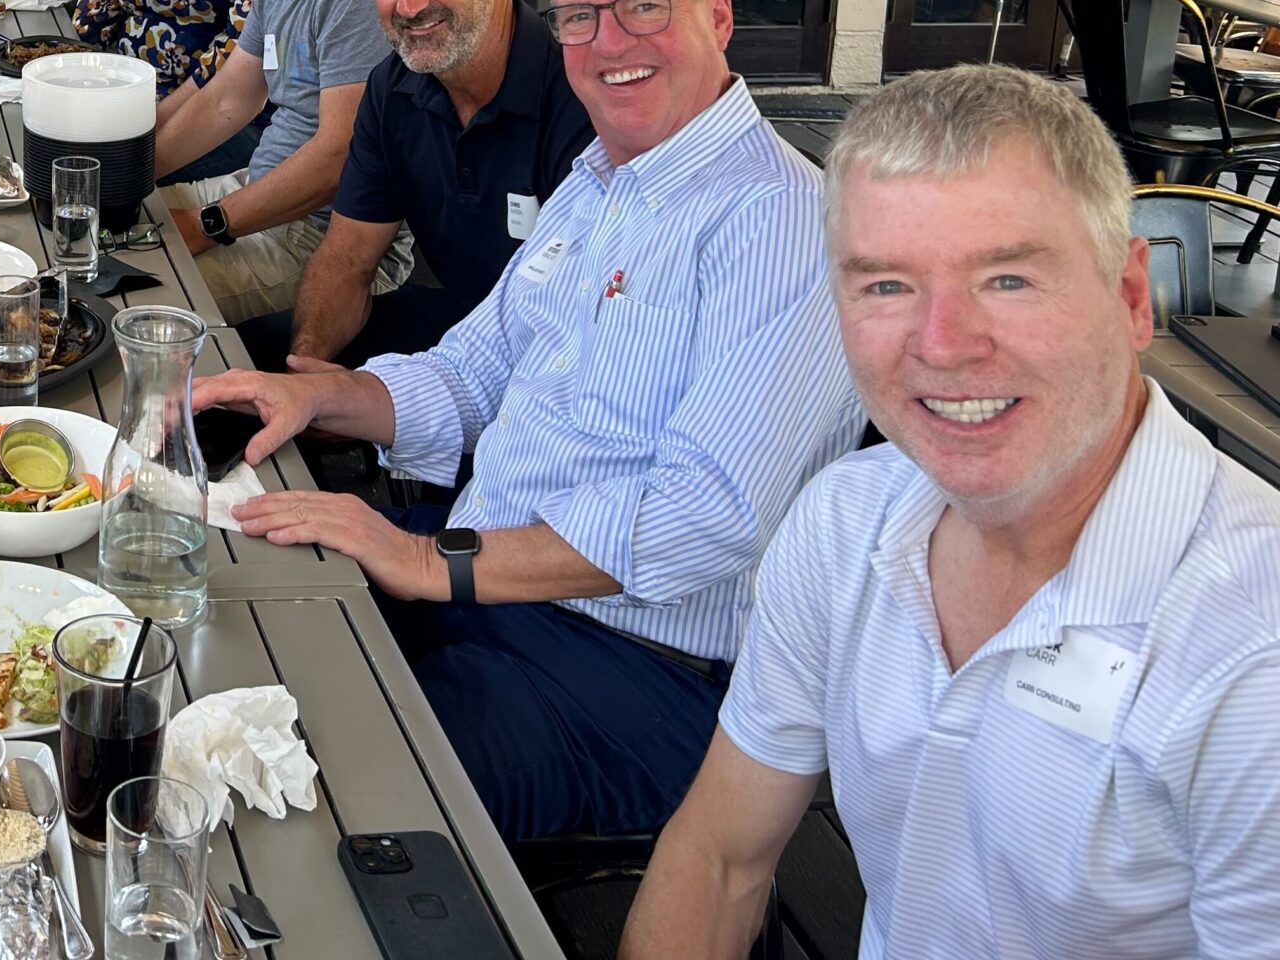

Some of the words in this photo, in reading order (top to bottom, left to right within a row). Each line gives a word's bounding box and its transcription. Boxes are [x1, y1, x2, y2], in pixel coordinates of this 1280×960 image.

[1025, 647, 1058, 667] CARR
[1016, 680, 1036, 694] CARR
[1035, 687, 1082, 713] CONSULTING
